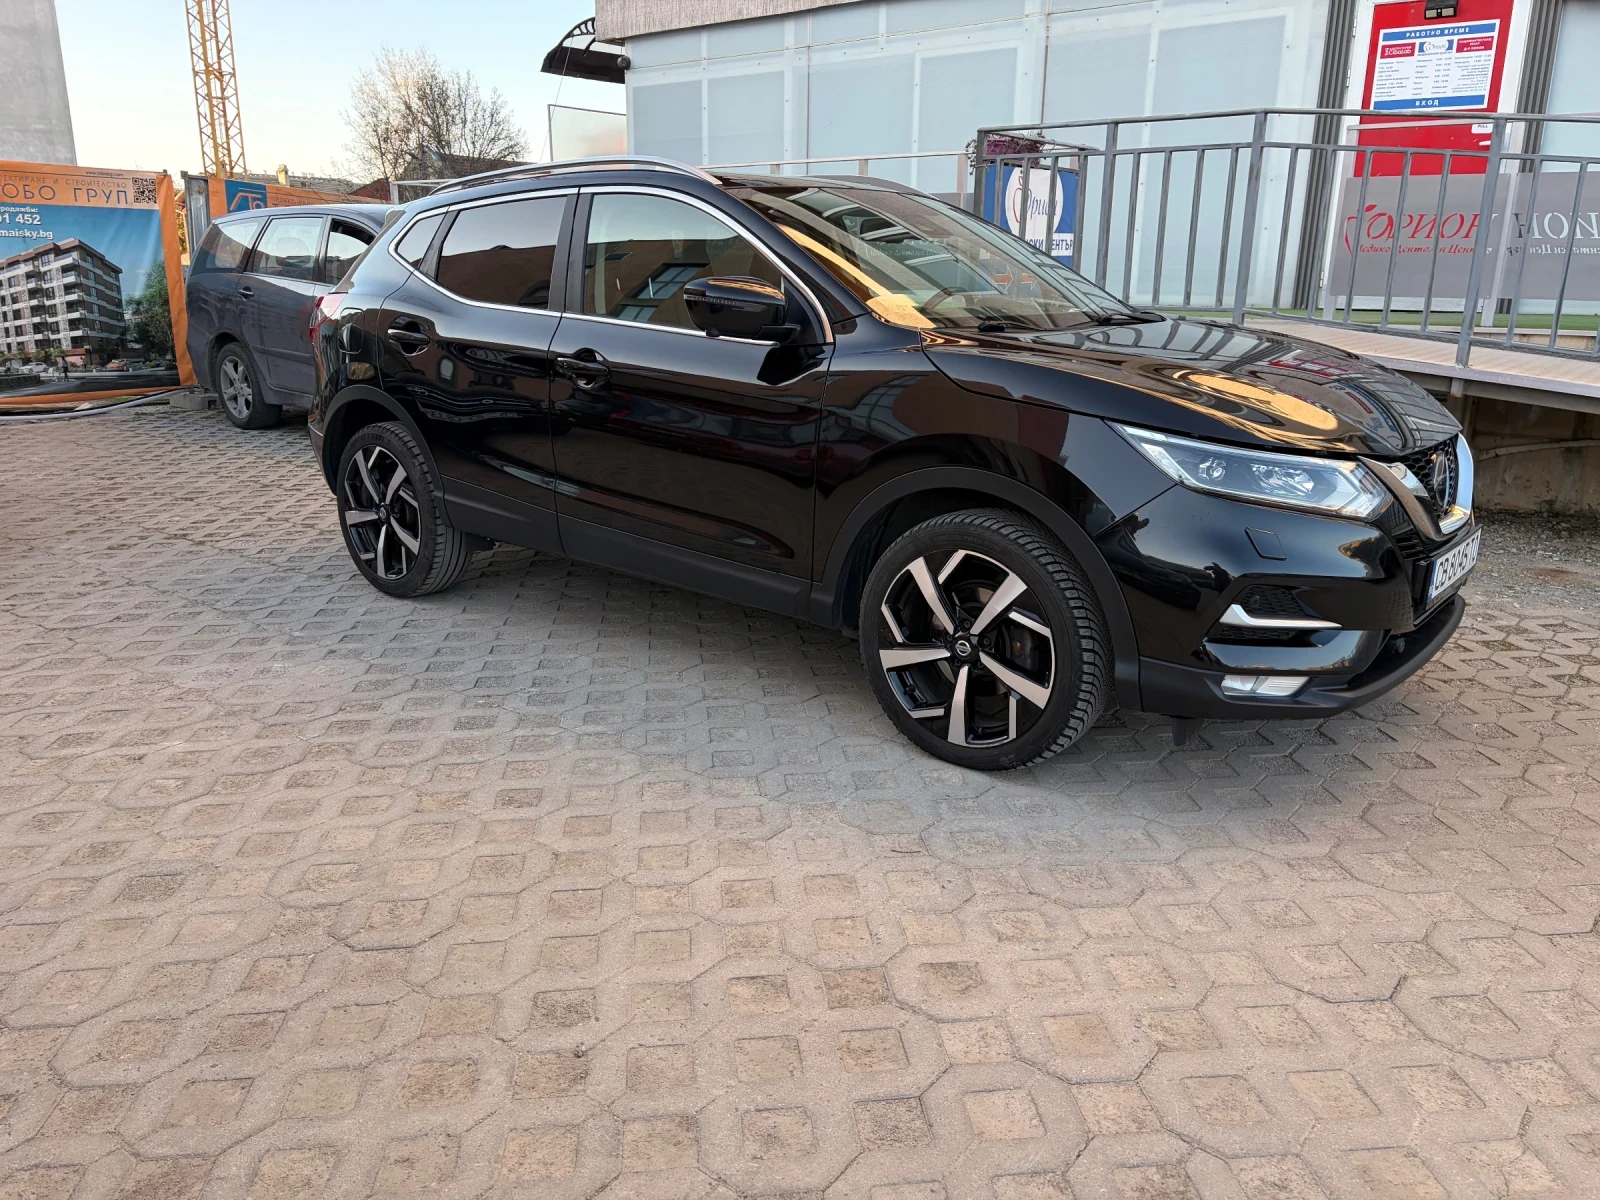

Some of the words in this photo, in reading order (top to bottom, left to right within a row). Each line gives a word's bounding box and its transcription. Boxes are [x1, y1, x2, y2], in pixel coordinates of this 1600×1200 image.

[1406, 30, 1441, 38] РАБОТНО
[1444, 27, 1470, 35] ВРЕМЕ
[1415, 99, 1440, 107] ВХОД
[65, 178, 127, 189] СТРОИТЕЛСТВО
[73, 187, 128, 204] ГРУП
[15, 213, 42, 225] 452
[0, 229, 53, 240] maisky.bg
[1051, 238, 1074, 251] ЕНТЪР
[1435, 558, 1449, 590] CB
